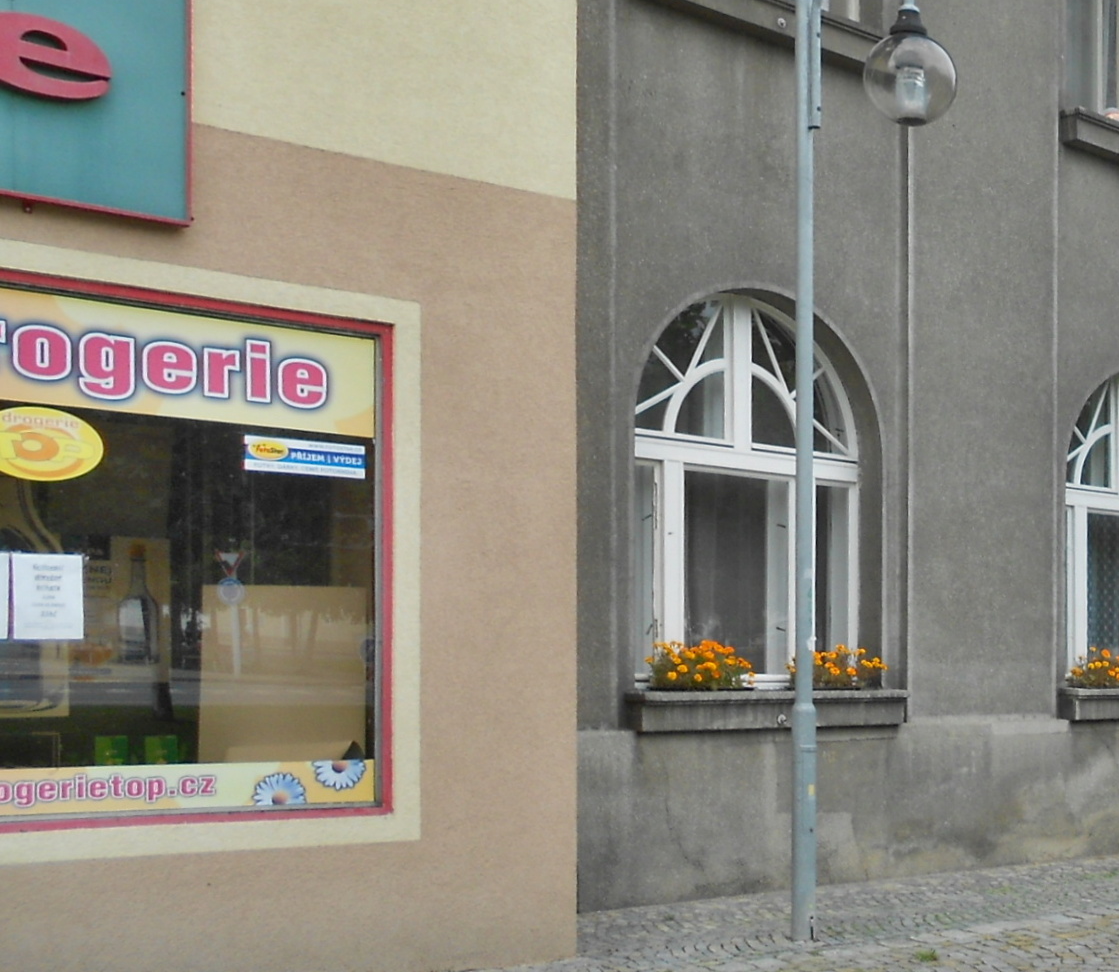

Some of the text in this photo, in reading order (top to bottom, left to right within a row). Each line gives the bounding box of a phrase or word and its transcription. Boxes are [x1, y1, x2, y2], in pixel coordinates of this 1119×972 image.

[0, 319, 328, 411] ogerie
[2, 412, 80, 429] drogerie
[333, 454, 363, 465] VÝDEJ
